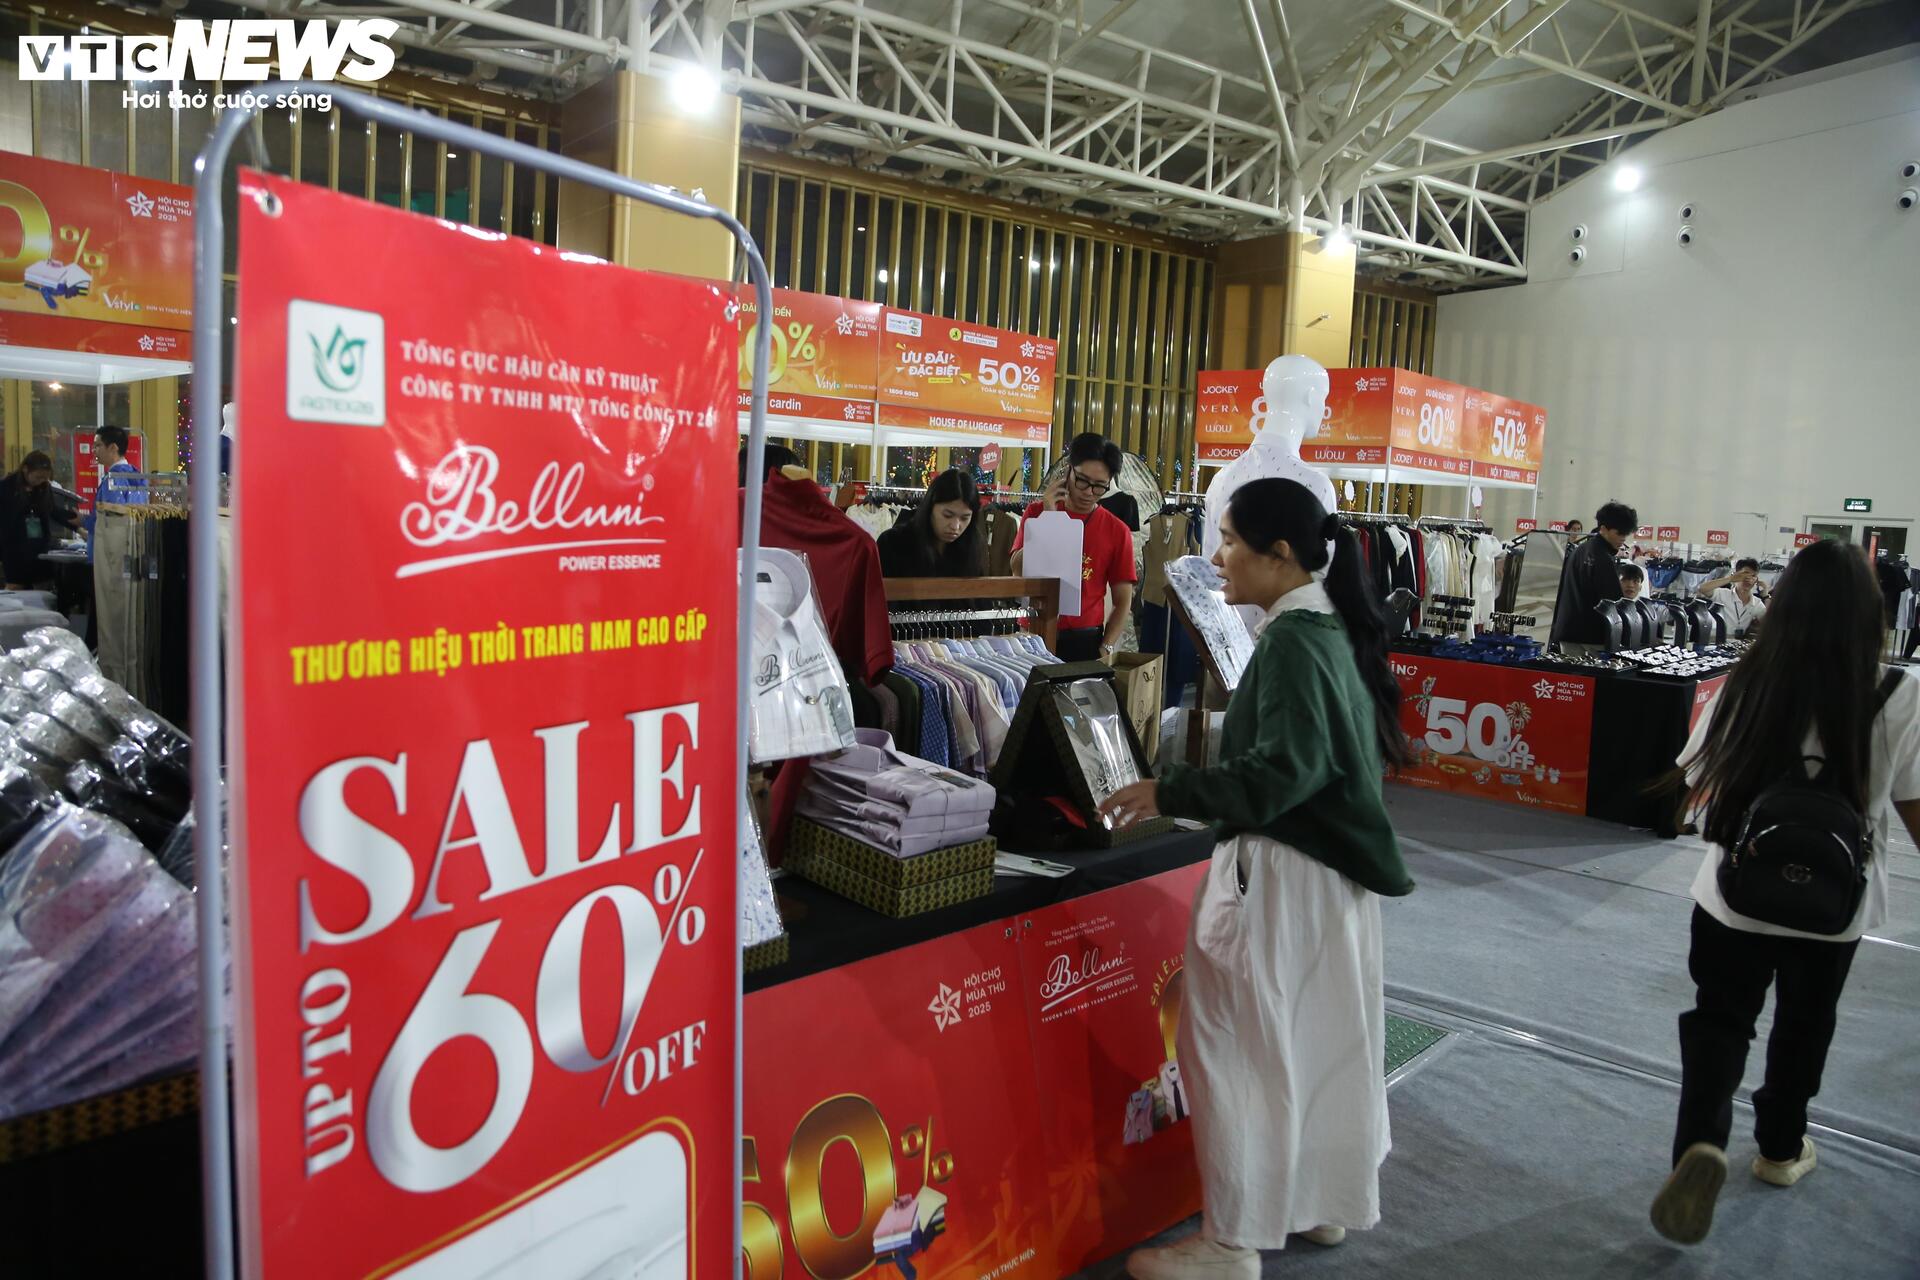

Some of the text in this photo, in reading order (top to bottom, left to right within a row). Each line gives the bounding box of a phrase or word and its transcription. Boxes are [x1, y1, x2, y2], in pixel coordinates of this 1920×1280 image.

[738, 319, 816, 385] 0%
[901, 350, 921, 364] ƯU
[402, 339, 658, 394] TỔNG CỤC HẬU CẦN KỸ THUẬT
[908, 363, 961, 378] ĐẶC BIỆT
[978, 358, 1040, 389] 50%
[1021, 383, 1040, 393] OFF
[1203, 385, 1238, 394] JOCKEY
[1398, 385, 1416, 397] JOCKEY
[401, 374, 453, 399] CÔNG
[460, 383, 484, 403] TY
[490, 386, 542, 410] TNHH
[589, 396, 629, 418] TỔNG
[634, 402, 674, 423] CÔNG
[676, 409, 694, 425] TY
[769, 398, 802, 411] cardin
[1200, 405, 1240, 414] VERA
[1396, 405, 1415, 417] VERA
[929, 416, 1002, 433] HOUSE OF LUGGAGE
[1418, 402, 1455, 447] 80%
[1491, 415, 1526, 459] 50%
[1207, 447, 1246, 457] JOCKEY
[1513, 448, 1525, 461] OFF
[1418, 456, 1438, 468] VERA
[1518, 521, 1535, 530] 40%
[1660, 530, 1676, 538] 40%
[1709, 533, 1727, 542] 40%
[559, 553, 661, 573] POWER ESSENCE
[290, 607, 707, 685] THƯƠNG HIỆU THỜI TRANG NAM CAO CẤP
[1557, 681, 1570, 690] HỘI
[1557, 688, 1585, 697] MÙA THU
[1424, 697, 1530, 762] 50%
[1496, 751, 1535, 771] OFF
[299, 701, 702, 956] SALE
[964, 965, 1002, 989] HỘI CHỢ
[1096, 973, 1135, 993] POWER ESSENCE
[965, 980, 1007, 1003] MÙA THU
[968, 1001, 992, 1019] 2025
[366, 848, 706, 1194] 60%
[623, 1019, 707, 1097] OFF
[302, 967, 355, 1180] UP TO
